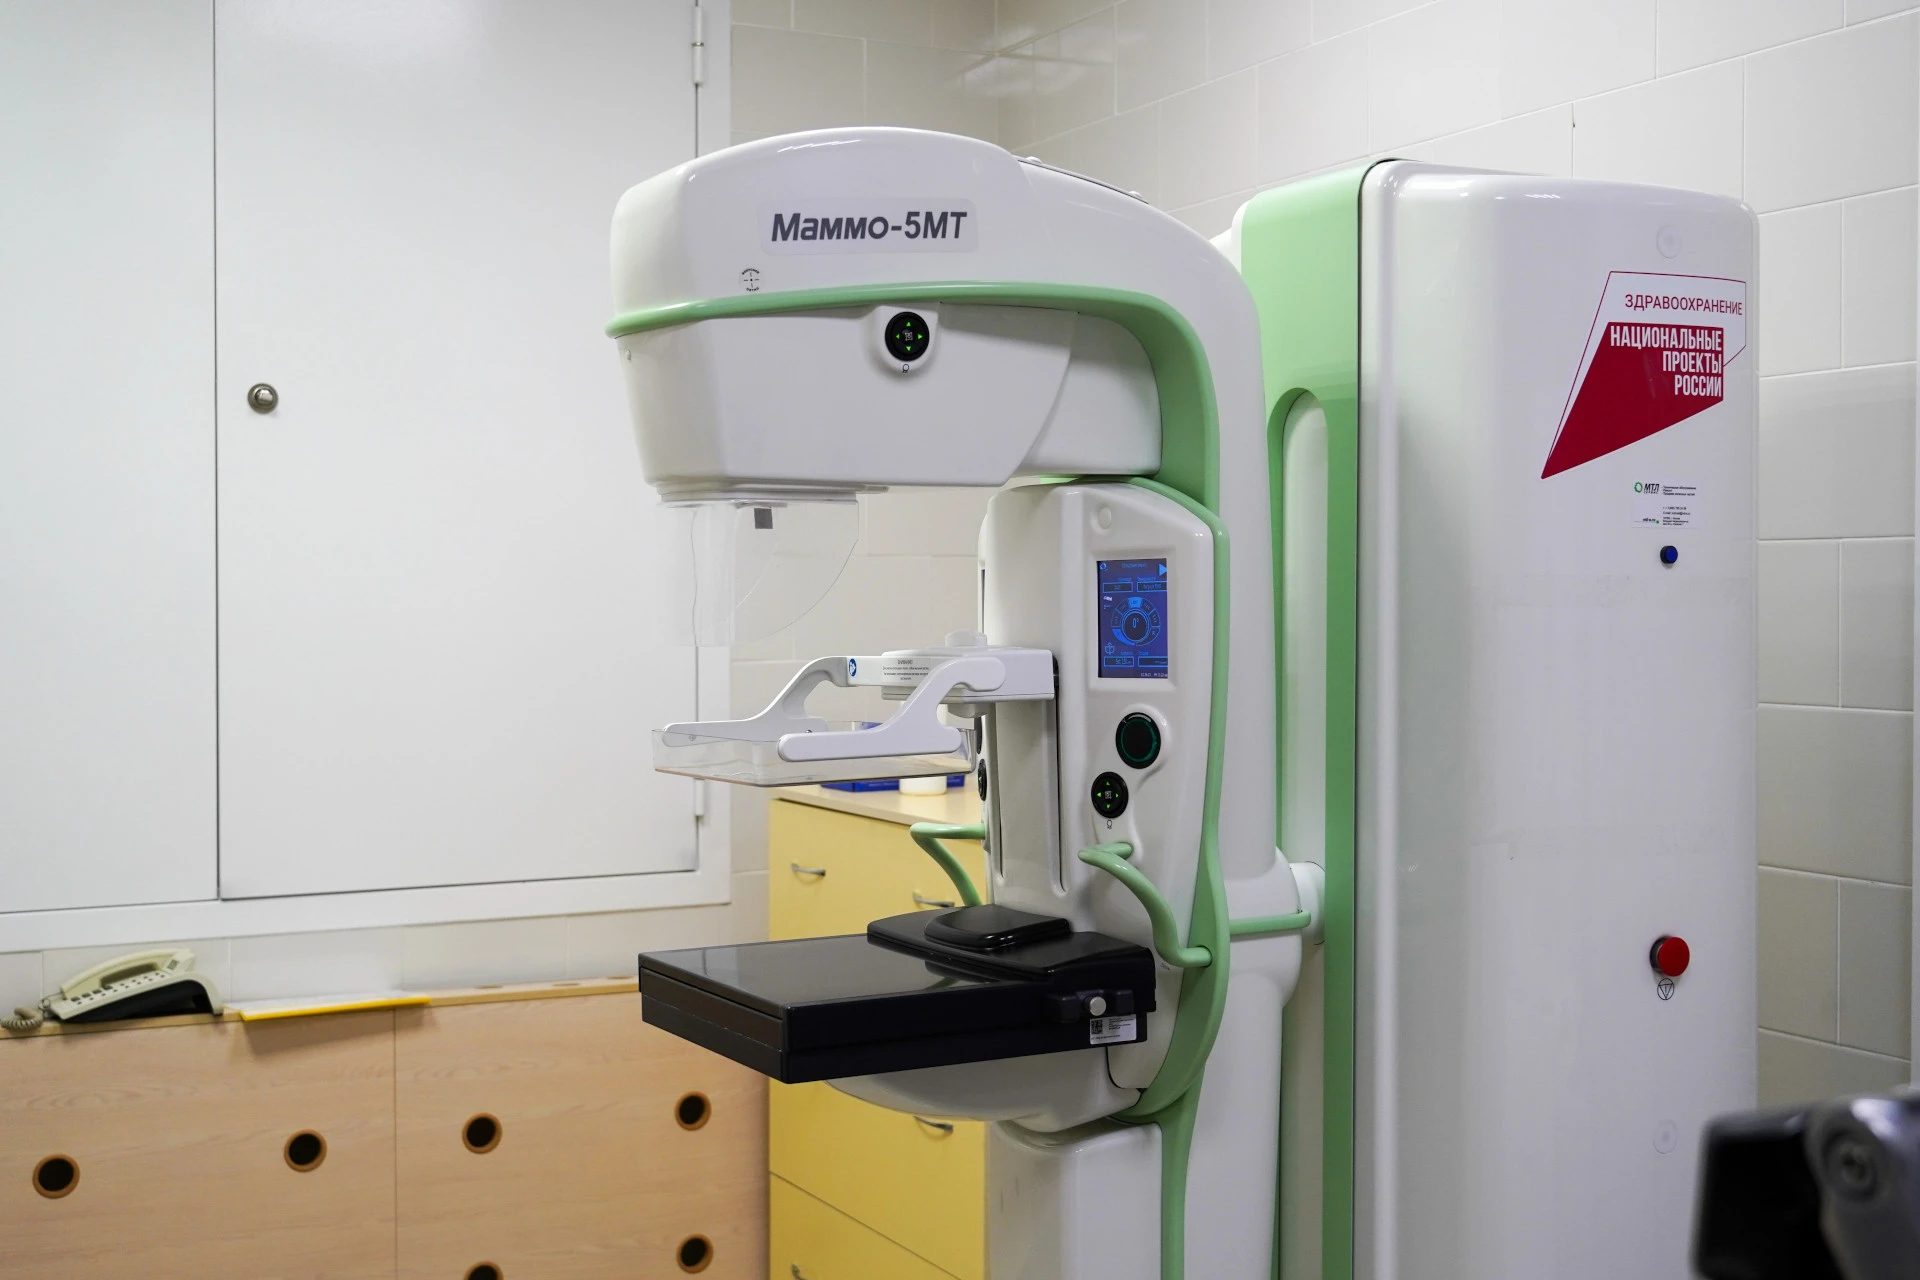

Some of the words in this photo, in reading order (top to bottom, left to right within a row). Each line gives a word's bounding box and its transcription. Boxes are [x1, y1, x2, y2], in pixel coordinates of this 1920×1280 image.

[771, 210, 968, 242] Маммо-5МТ
[1625, 293, 1743, 316] ЗДРАВООХРАНЕНИЕ
[1610, 325, 1722, 352] НАЦИОНАЛЬНЫЕ
[1662, 351, 1722, 375] ПРОЕКТЫ
[1674, 375, 1722, 398] РОССИИ
